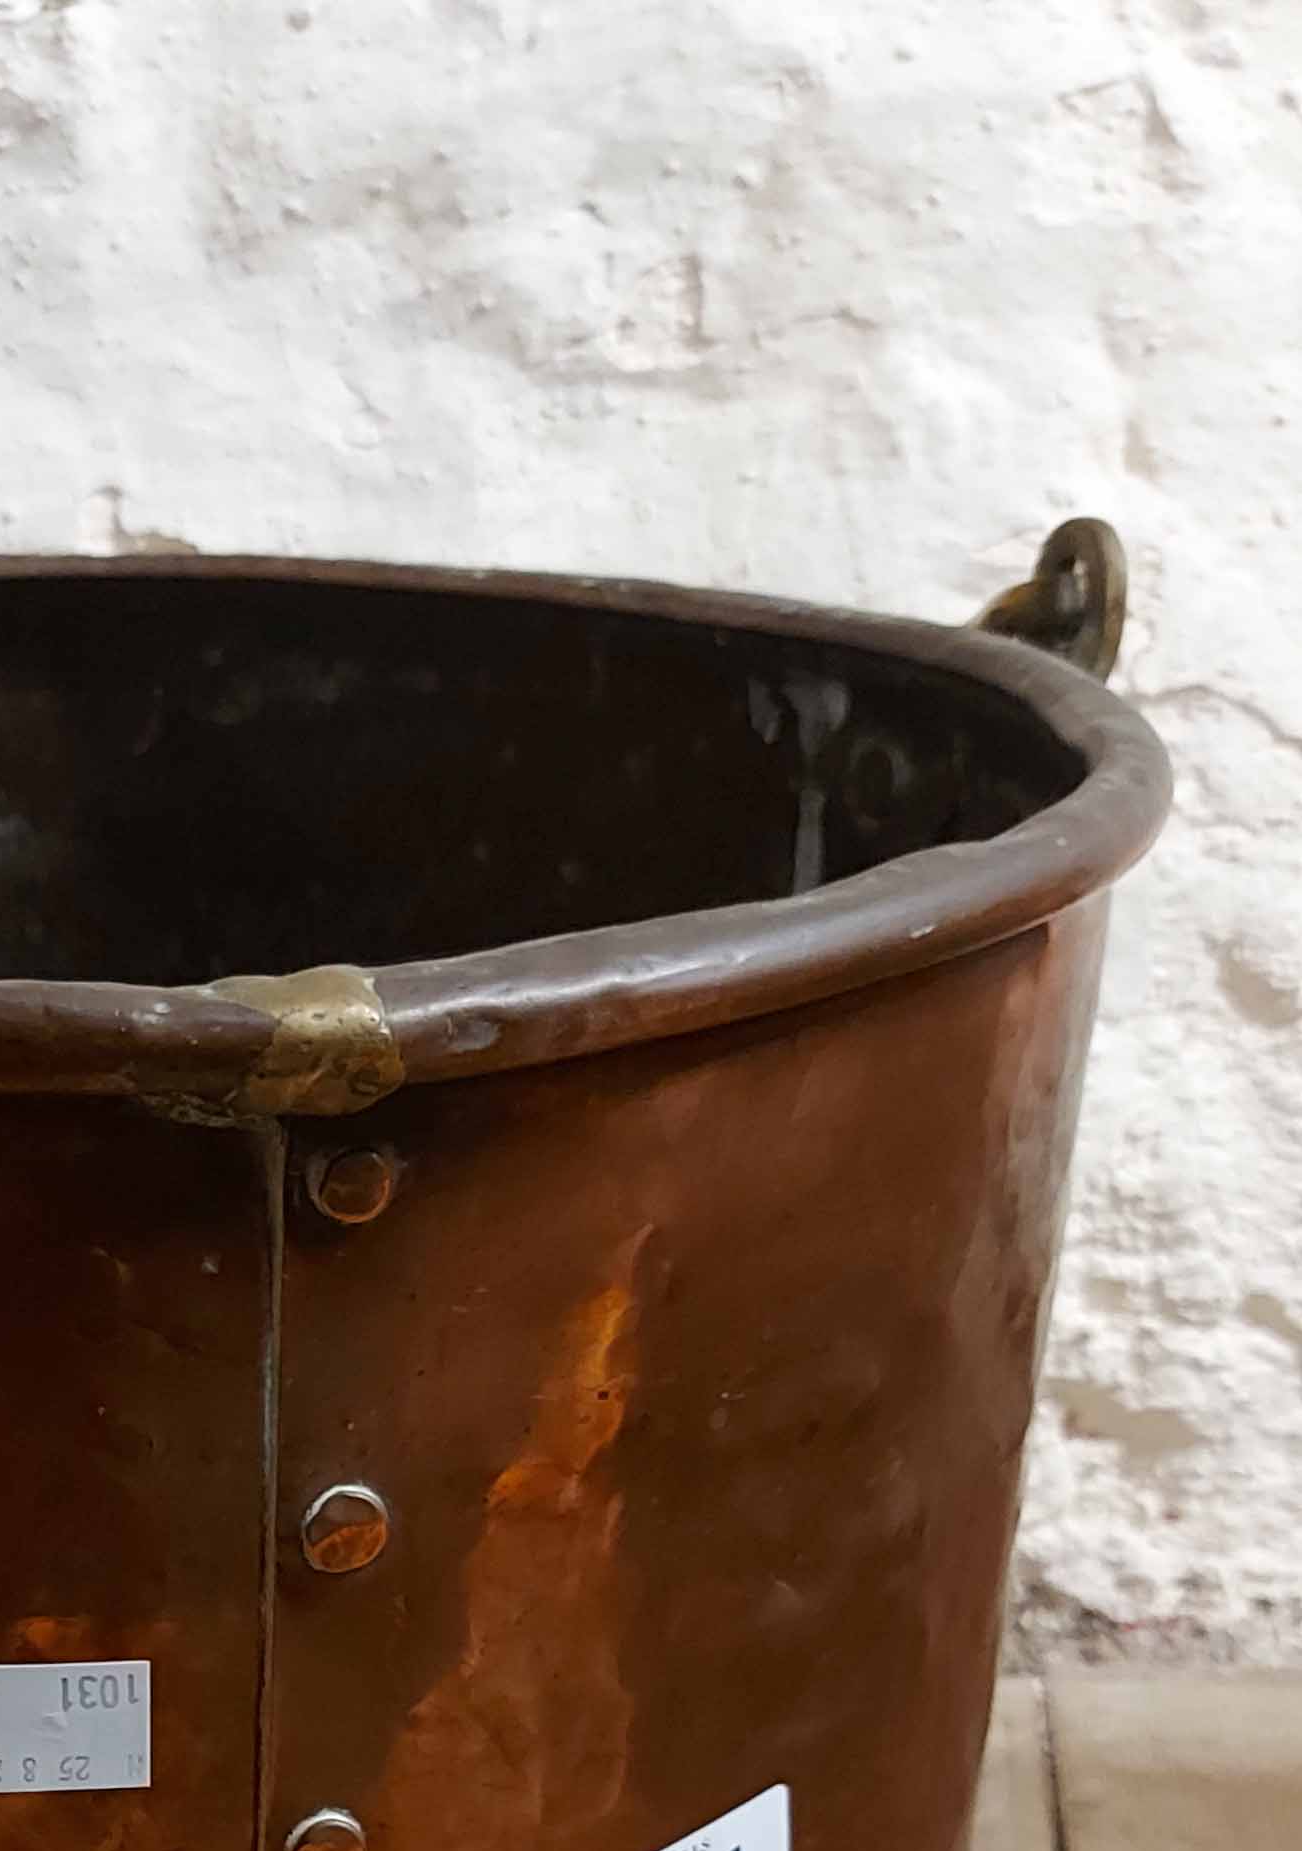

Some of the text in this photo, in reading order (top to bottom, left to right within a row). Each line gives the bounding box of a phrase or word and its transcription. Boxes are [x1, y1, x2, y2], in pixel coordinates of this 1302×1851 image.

[60, 1674, 139, 1712] 1031
[22, 1757, 37, 1782] 8
[59, 1756, 90, 1781] 25
